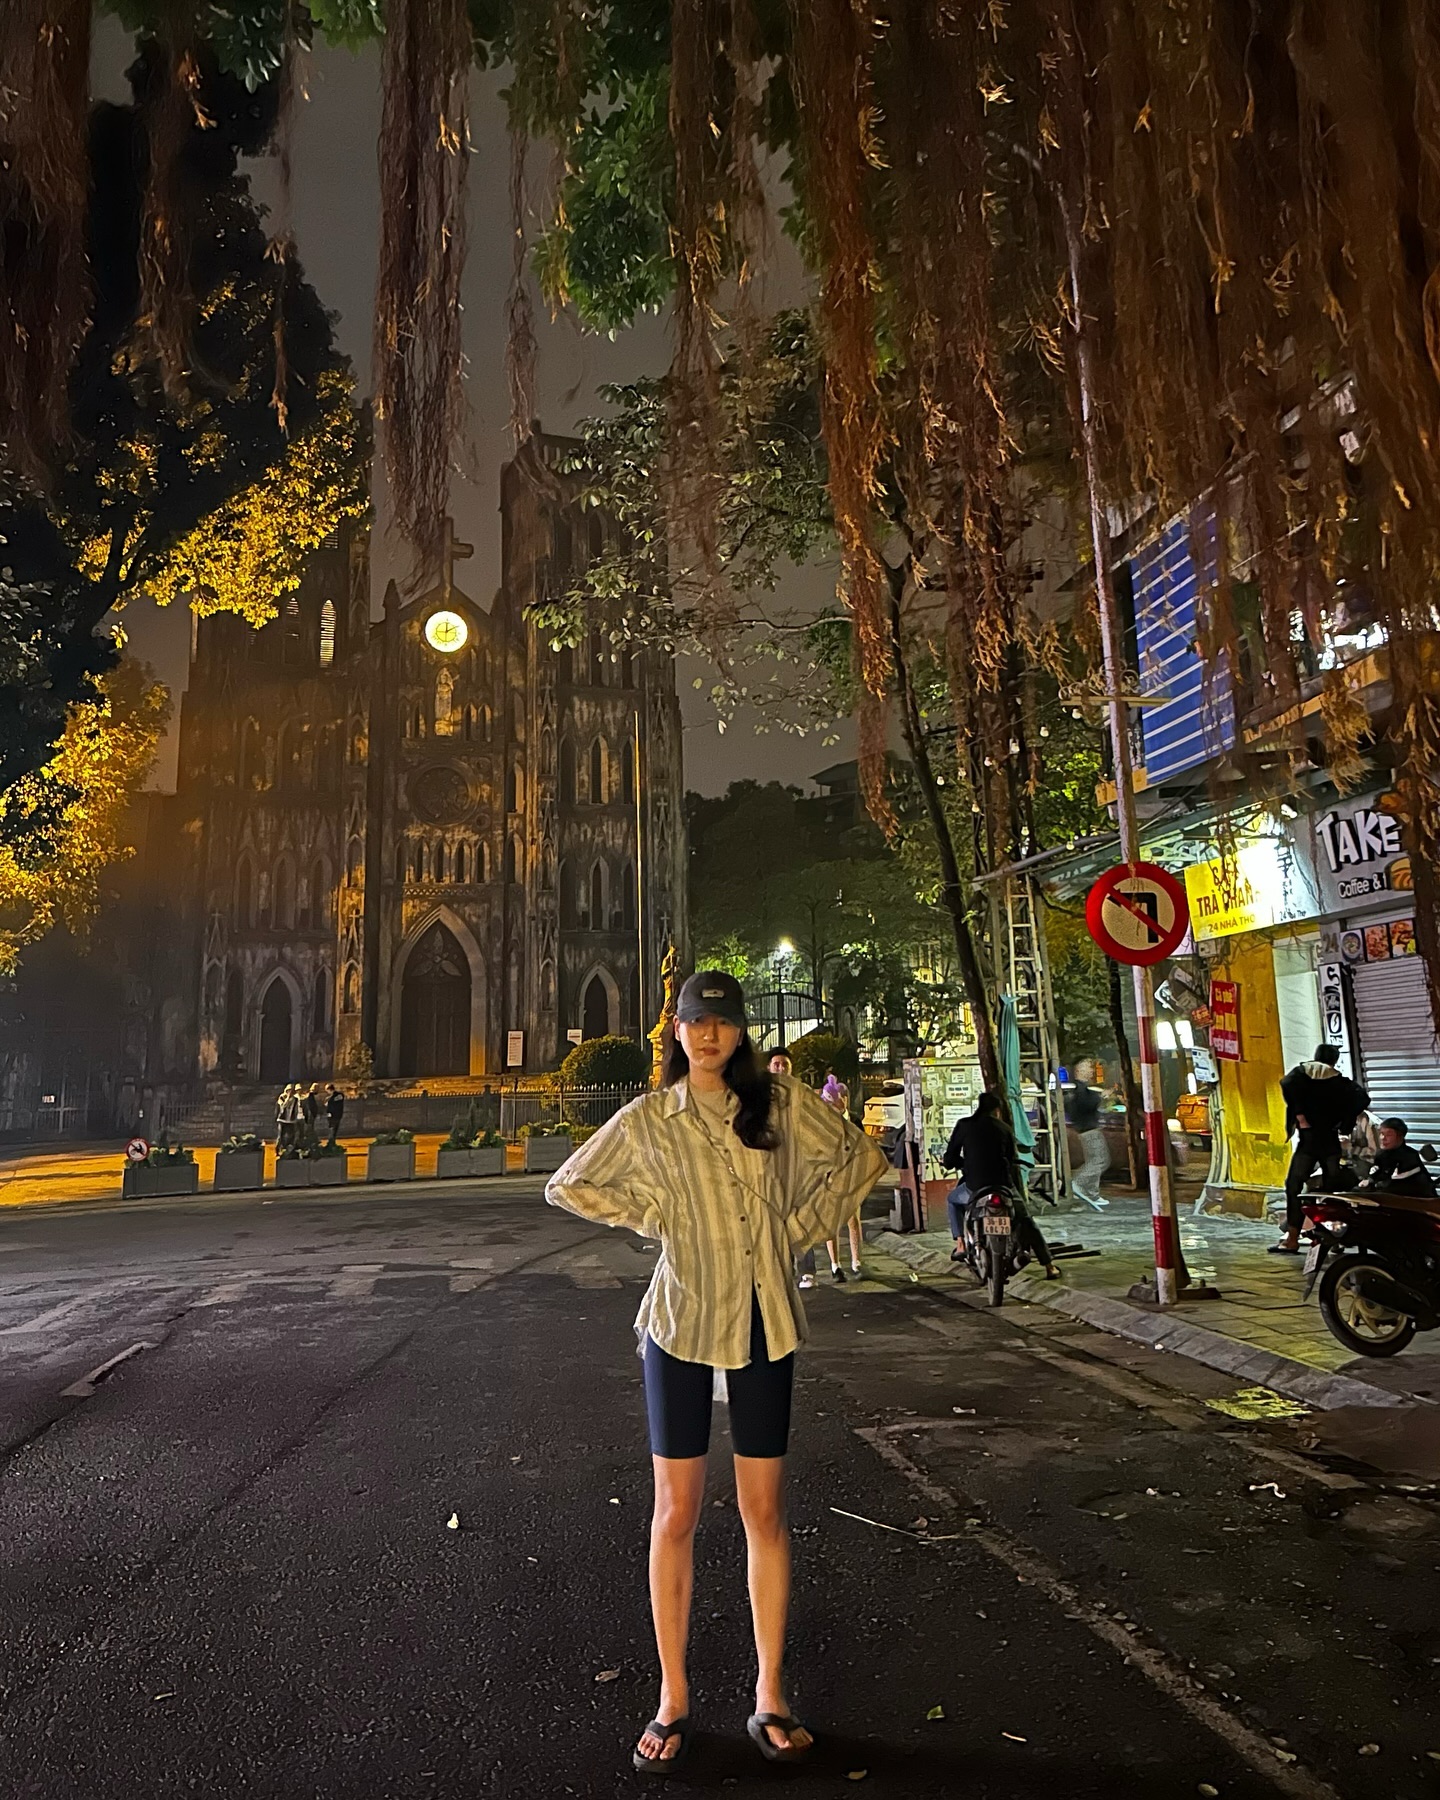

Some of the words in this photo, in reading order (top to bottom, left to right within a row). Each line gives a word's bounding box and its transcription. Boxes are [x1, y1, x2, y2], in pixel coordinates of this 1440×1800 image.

[1315, 809, 1401, 872] TAKE
[1338, 877, 1370, 898] Coffee
[1372, 873, 1382, 890] &
[1196, 889, 1219, 918] TRÀ
[1208, 922, 1219, 933] 24
